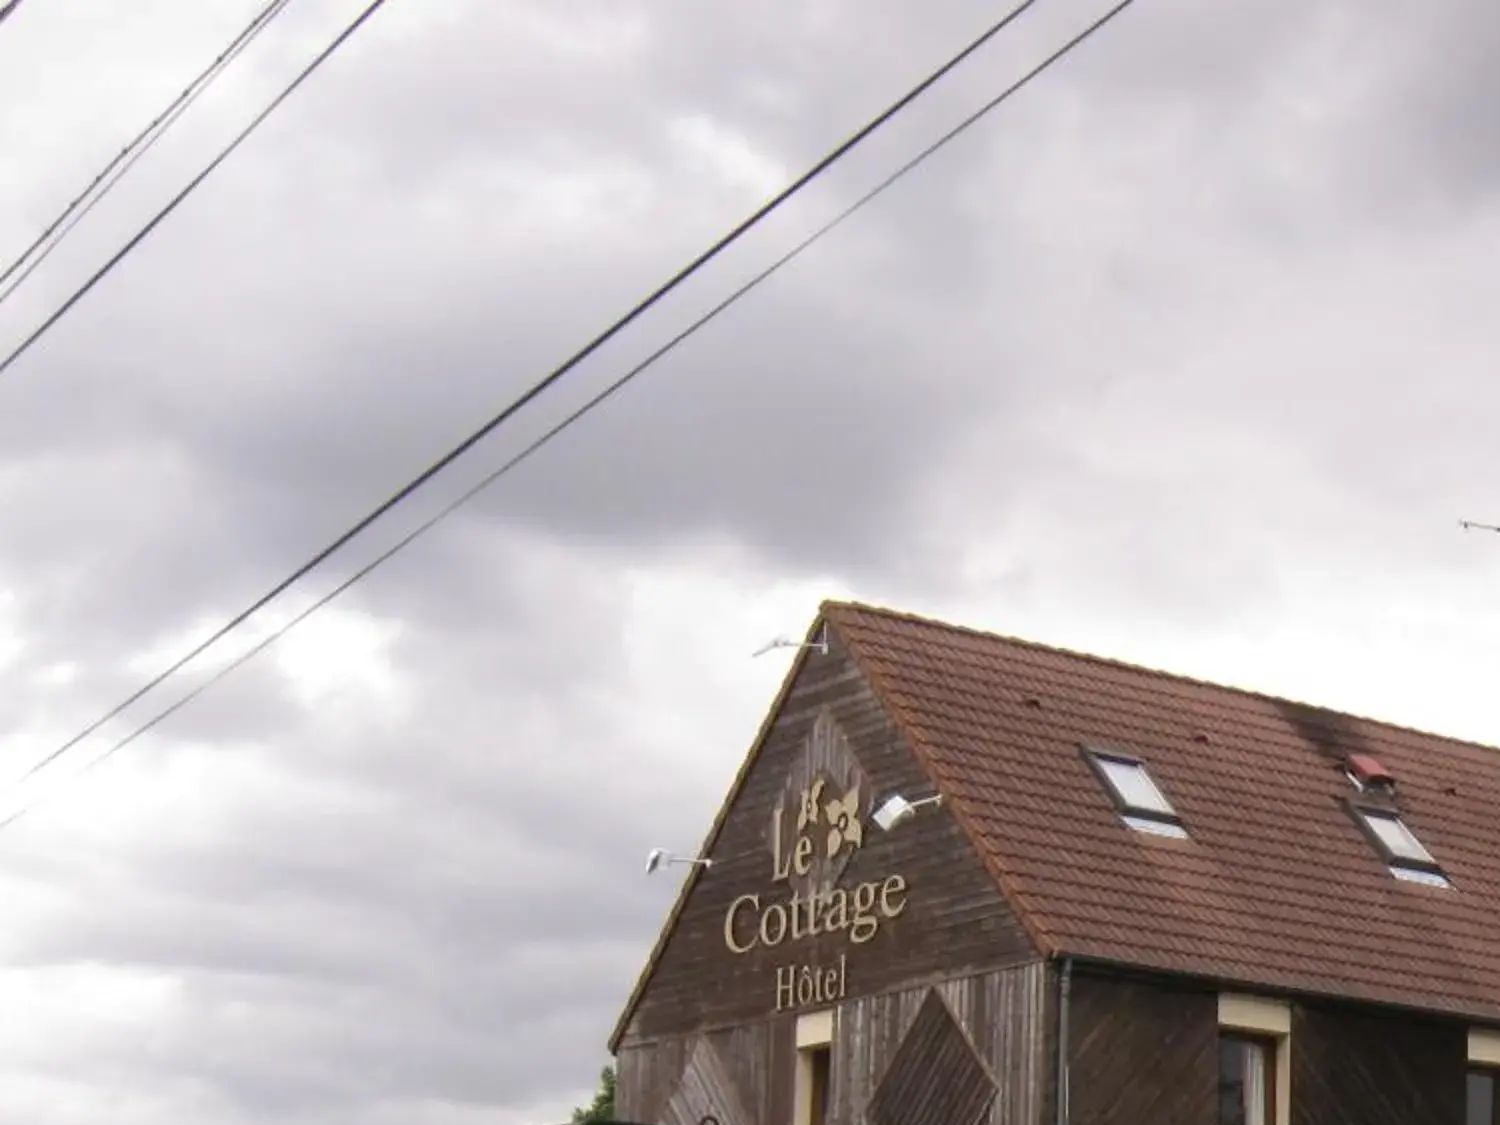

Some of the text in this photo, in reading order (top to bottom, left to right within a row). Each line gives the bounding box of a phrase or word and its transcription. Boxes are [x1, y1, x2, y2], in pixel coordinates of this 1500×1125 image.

[771, 806, 812, 882] Le
[724, 874, 907, 954] Cottage
[775, 953, 847, 1011] Hôtel
